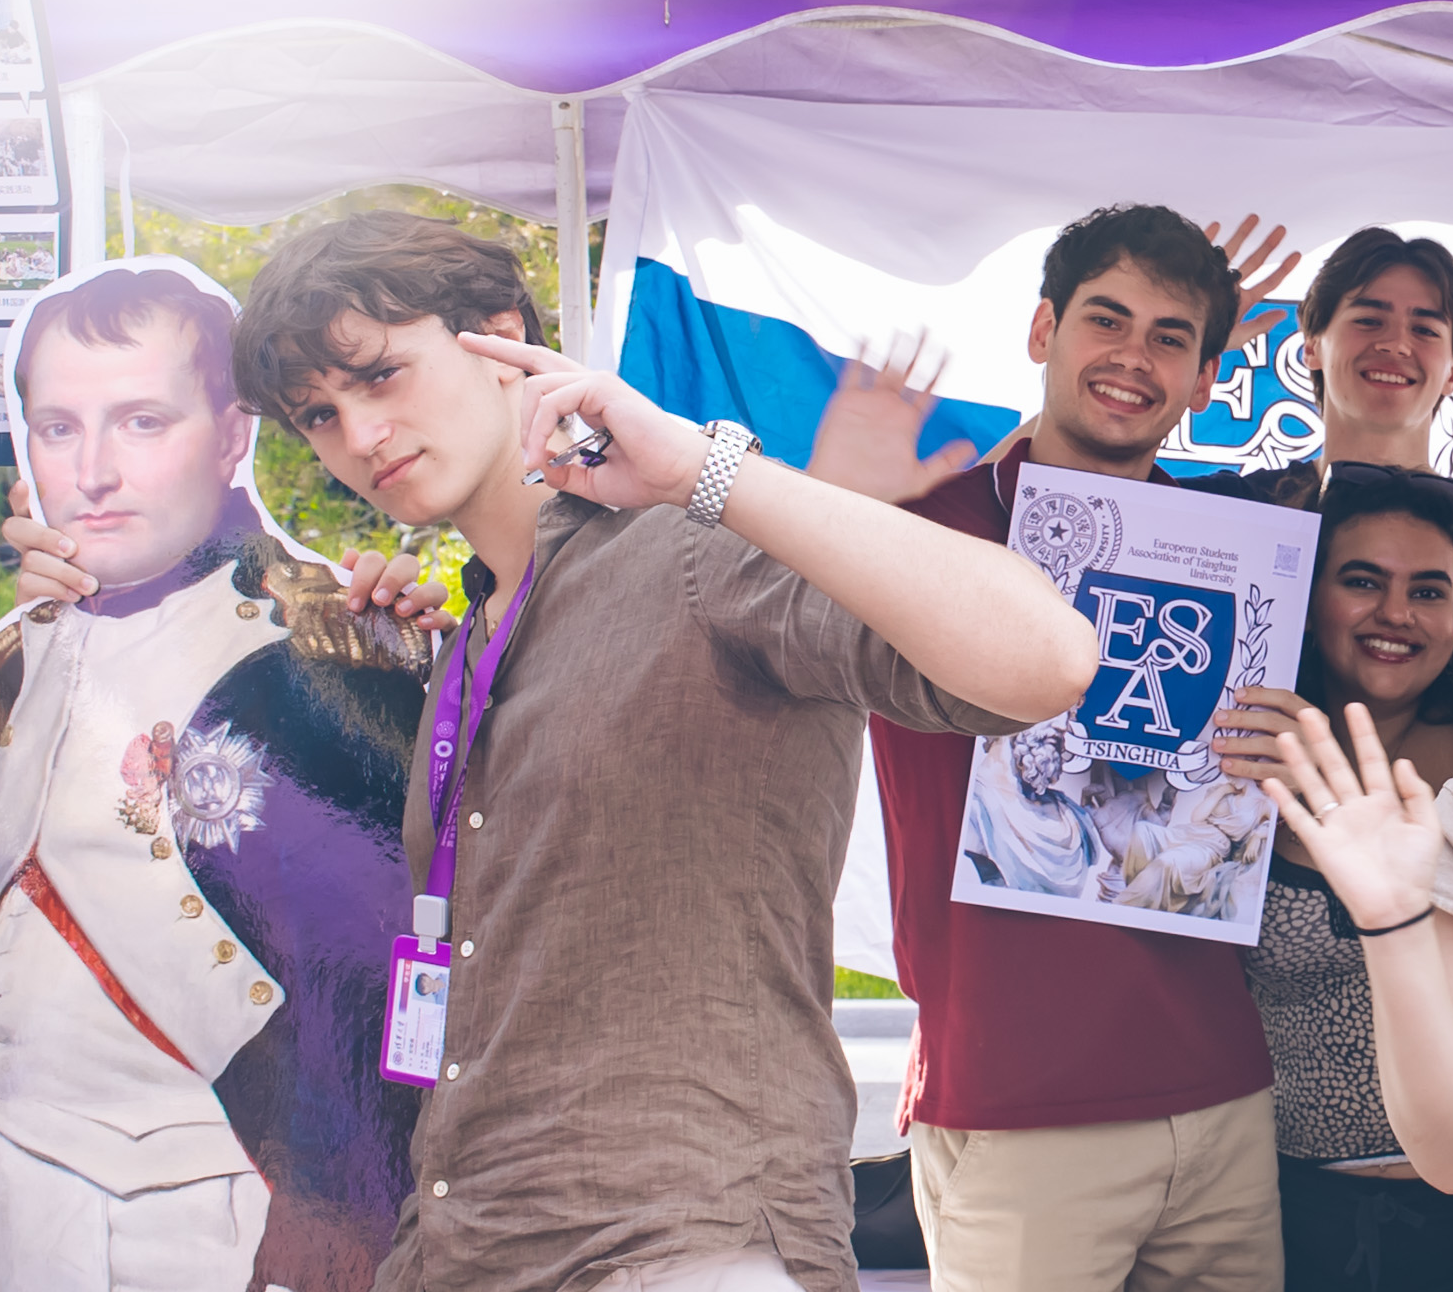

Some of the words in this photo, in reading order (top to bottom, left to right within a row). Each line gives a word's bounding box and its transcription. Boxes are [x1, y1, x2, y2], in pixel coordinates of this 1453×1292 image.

[1127, 546, 1181, 565] Association
[1182, 552, 1195, 566] of
[1195, 557, 1238, 576] Tsinghua
[1153, 537, 1199, 558] European
[1199, 545, 1240, 563] Students
[1189, 567, 1236, 587] University
[1082, 741, 1181, 769] TSINGHUA
